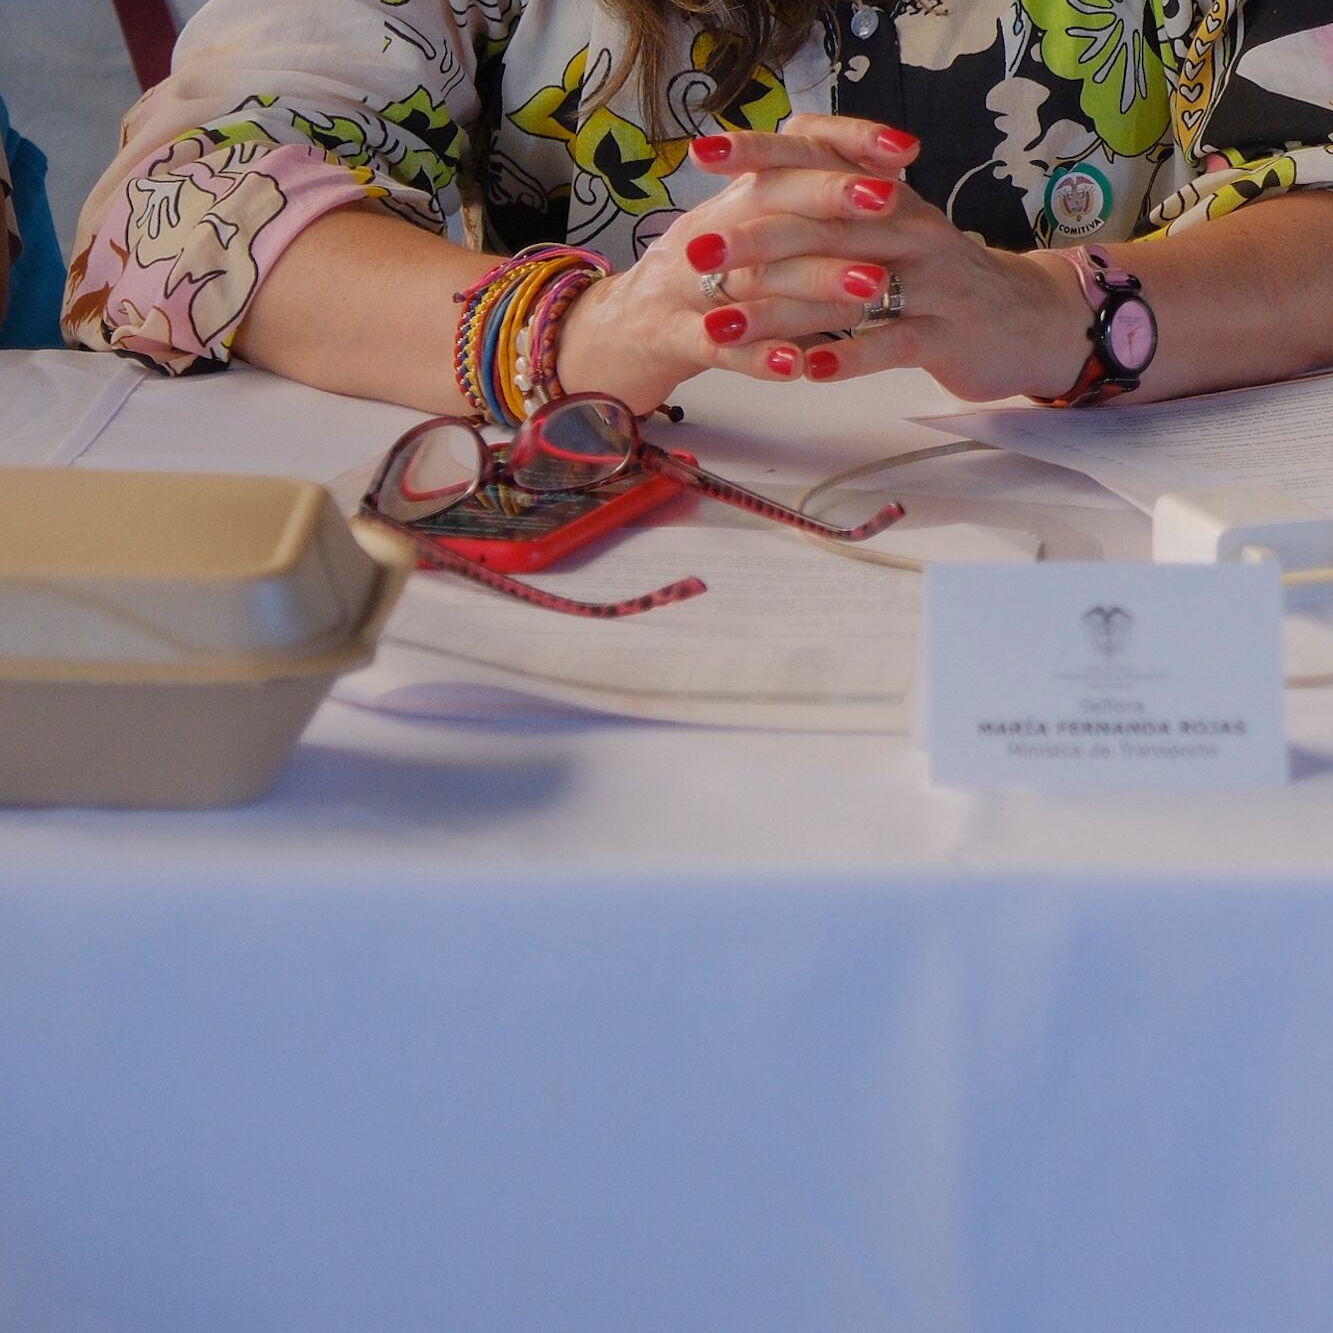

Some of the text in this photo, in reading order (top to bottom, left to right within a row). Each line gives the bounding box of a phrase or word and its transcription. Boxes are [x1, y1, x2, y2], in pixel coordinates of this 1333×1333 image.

[1058, 219, 1102, 235] COMITIVA
[977, 719, 1247, 737] MARÍA FERNANDA ROJAS
